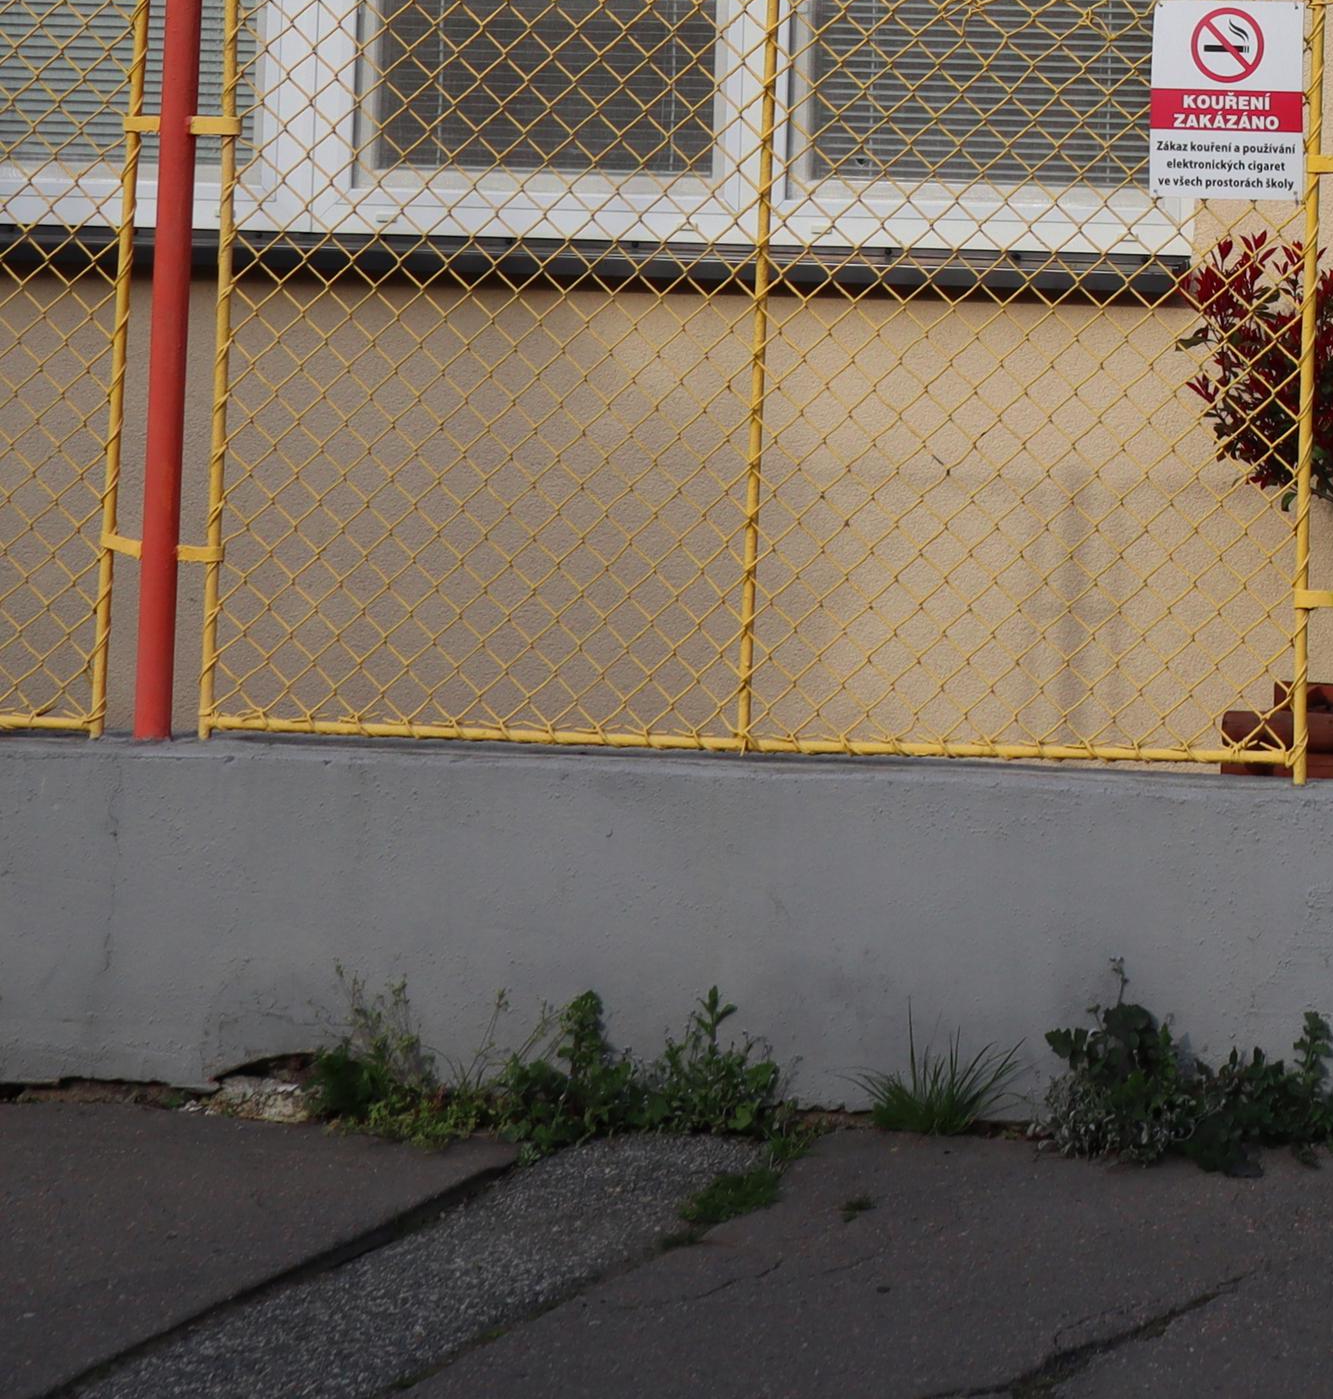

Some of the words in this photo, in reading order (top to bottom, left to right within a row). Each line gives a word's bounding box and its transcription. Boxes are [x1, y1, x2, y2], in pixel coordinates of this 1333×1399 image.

[1182, 92, 1271, 111] KOUŘENÍ
[1173, 113, 1279, 130] ZAKÁZÁNO
[1156, 141, 1188, 152] Zákaz
[1190, 141, 1232, 153] kouření
[1233, 145, 1240, 153] a
[1242, 143, 1296, 155] používání
[1166, 159, 1245, 173] elektronických
[1247, 161, 1285, 174] cigaret
[1158, 178, 1171, 186] ve
[1173, 175, 1202, 187] všech
[1205, 176, 1263, 190] prostorách
[1265, 177, 1294, 191] školy
